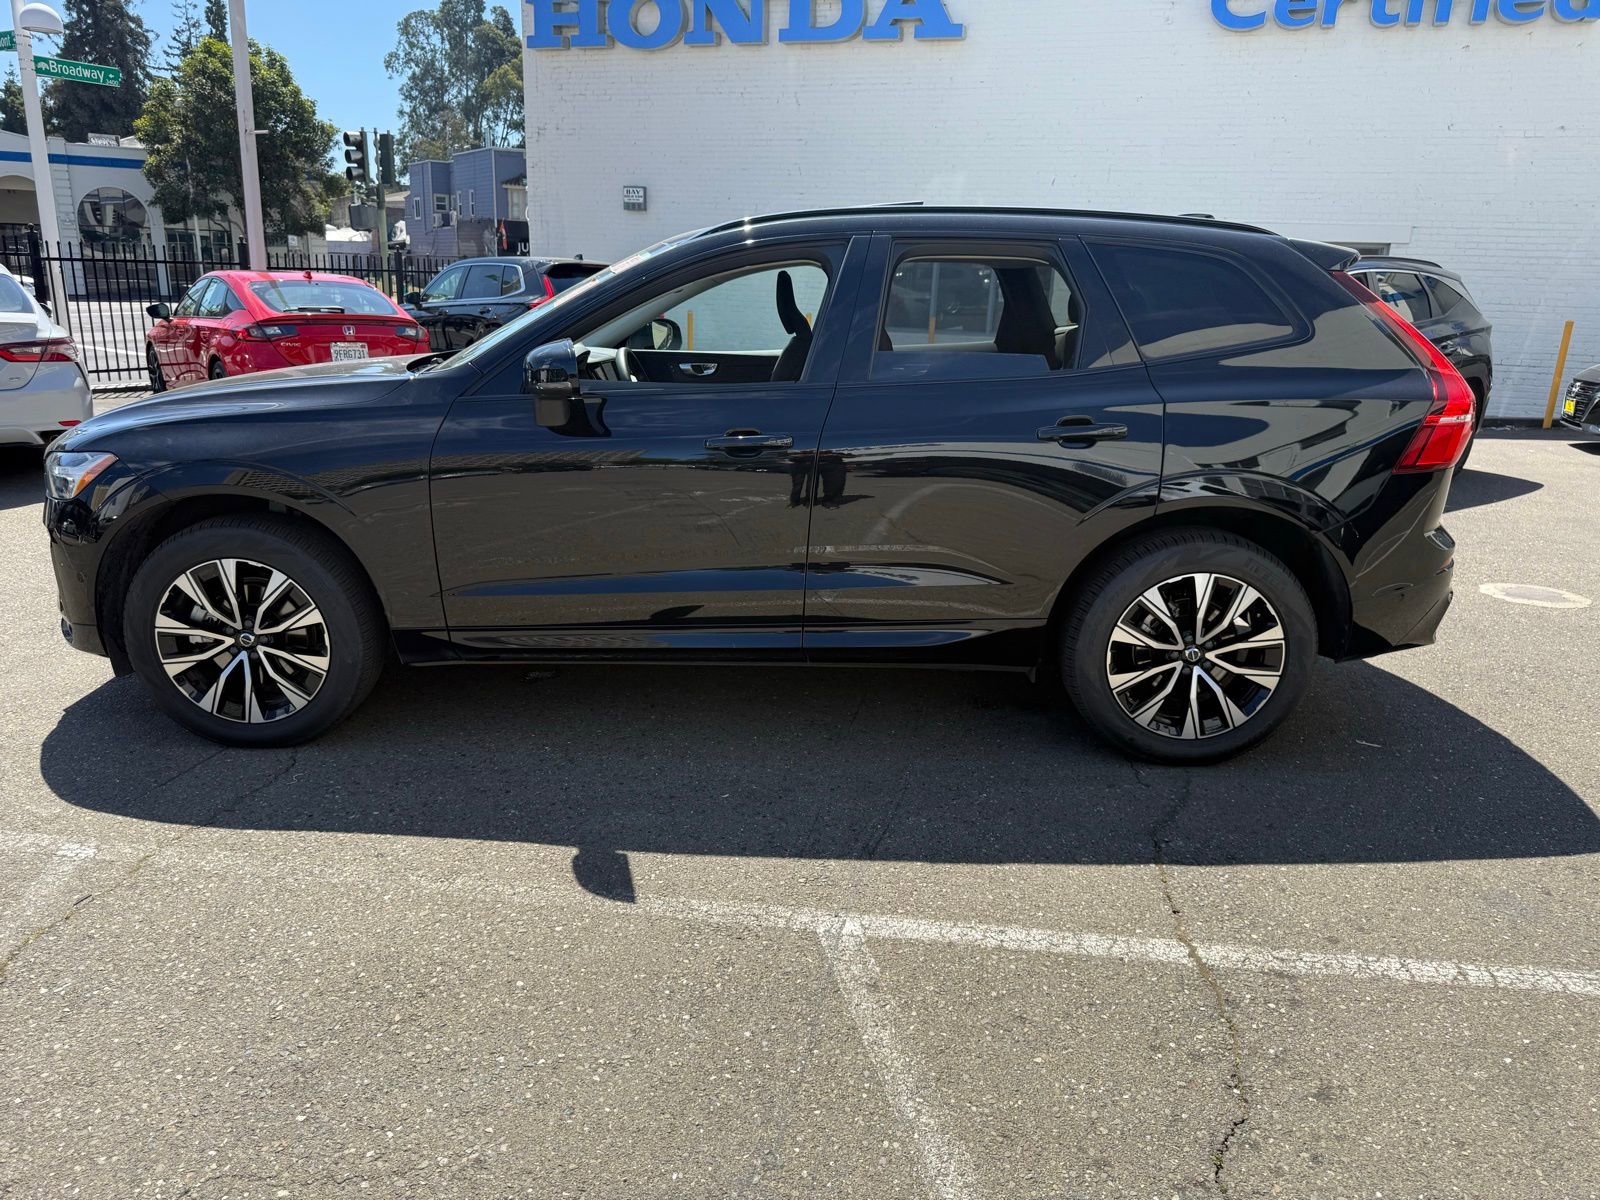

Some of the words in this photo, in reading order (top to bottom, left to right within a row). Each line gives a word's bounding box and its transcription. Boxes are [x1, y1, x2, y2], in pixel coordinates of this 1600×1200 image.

[527, 0, 965, 50] HONDA
[0, 34, 11, 48] ont
[49, 60, 105, 82] Broadway
